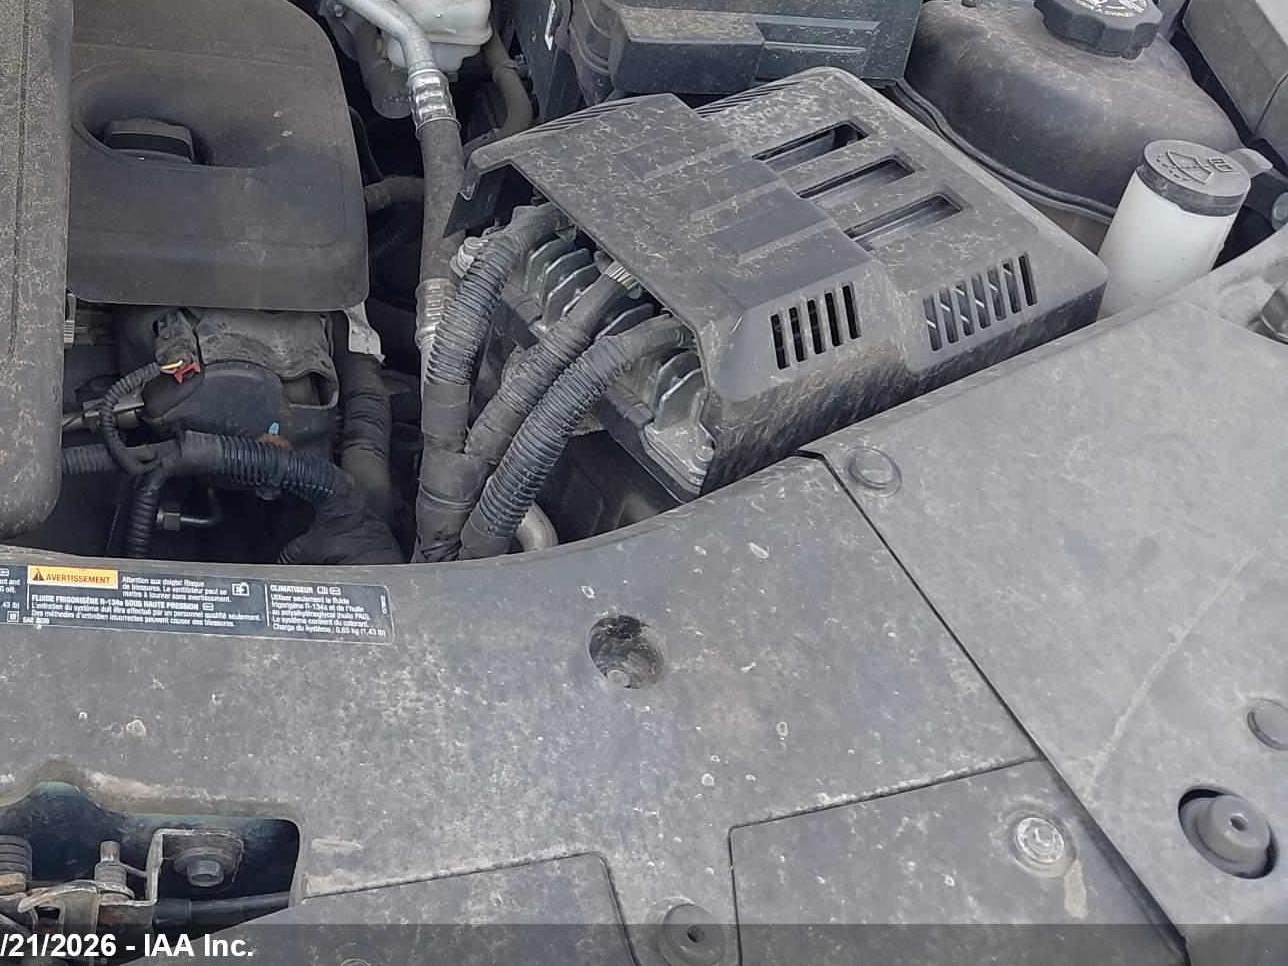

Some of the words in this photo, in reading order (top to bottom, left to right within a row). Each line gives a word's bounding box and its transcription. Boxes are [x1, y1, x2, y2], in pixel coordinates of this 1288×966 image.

[46, 574, 111, 584] AVERTISSEMENT
[122, 576, 148, 584] Attention
[270, 584, 314, 594] CLIMATISEUR
[100, 598, 124, 606] R-134a
[124, 600, 142, 608] SOUS
[144, 600, 165, 608] HAUTE
[166, 602, 198, 610] PRESSION
[293, 596, 324, 604] seulement
[305, 603, 328, 611] R-134a
[174, 610, 204, 618] personnel
[273, 623, 294, 632] Charge
[352, 628, 360, 636] kg
